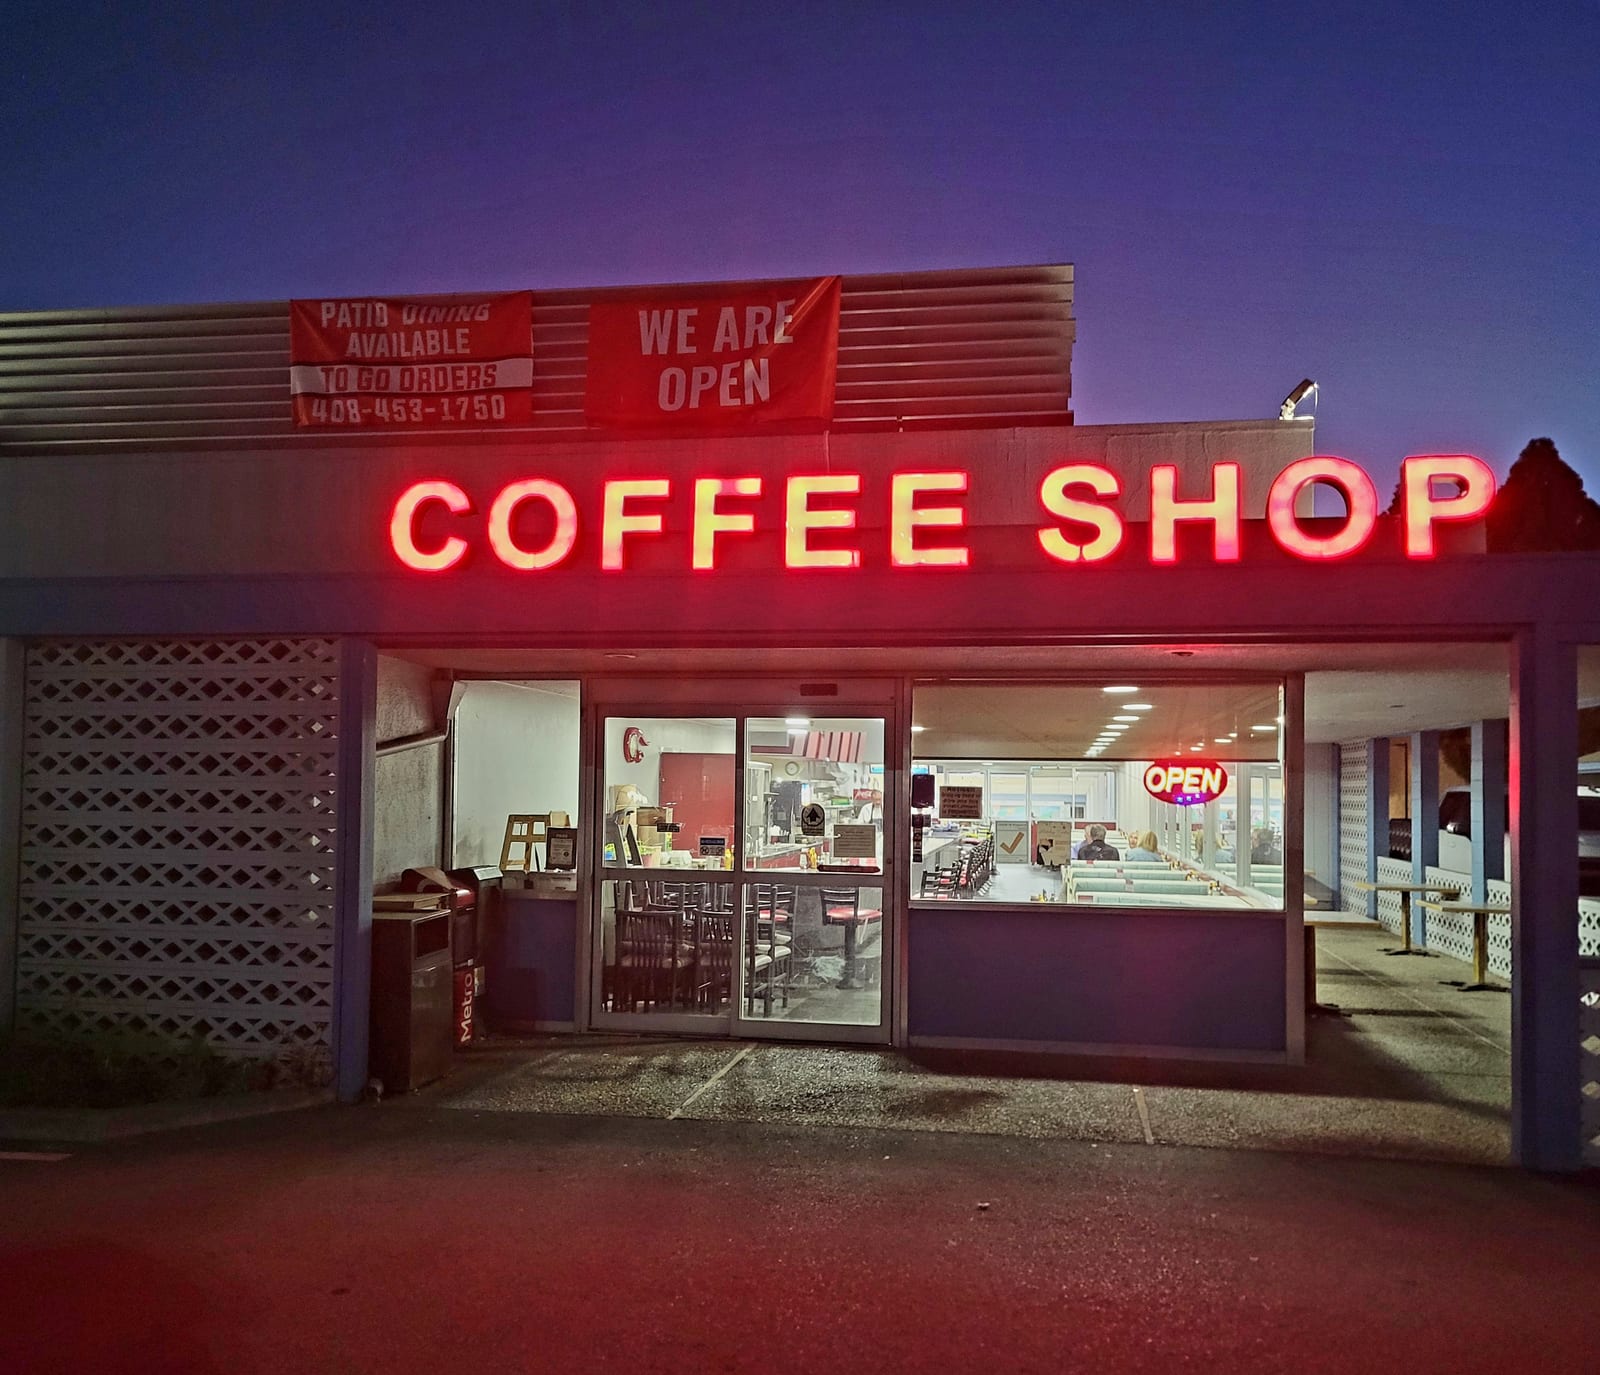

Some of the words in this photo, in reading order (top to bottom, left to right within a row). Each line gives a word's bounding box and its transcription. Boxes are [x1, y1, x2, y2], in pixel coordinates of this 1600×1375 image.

[321, 302, 388, 328] PATIO
[402, 303, 490, 325] DINING
[638, 308, 698, 355] WE
[712, 299, 796, 352] ARE
[346, 328, 470, 358] AVAILABLE
[321, 367, 348, 392] TO
[357, 366, 391, 392] GO
[400, 363, 497, 392] ORDERS
[658, 358, 770, 412] OPEN
[312, 394, 506, 423] 408-453-1750
[389, 472, 969, 571] COFFEE
[1038, 454, 1497, 563] SHOP
[1145, 766, 1222, 794] OPEN
[461, 973, 473, 1042] Metro
